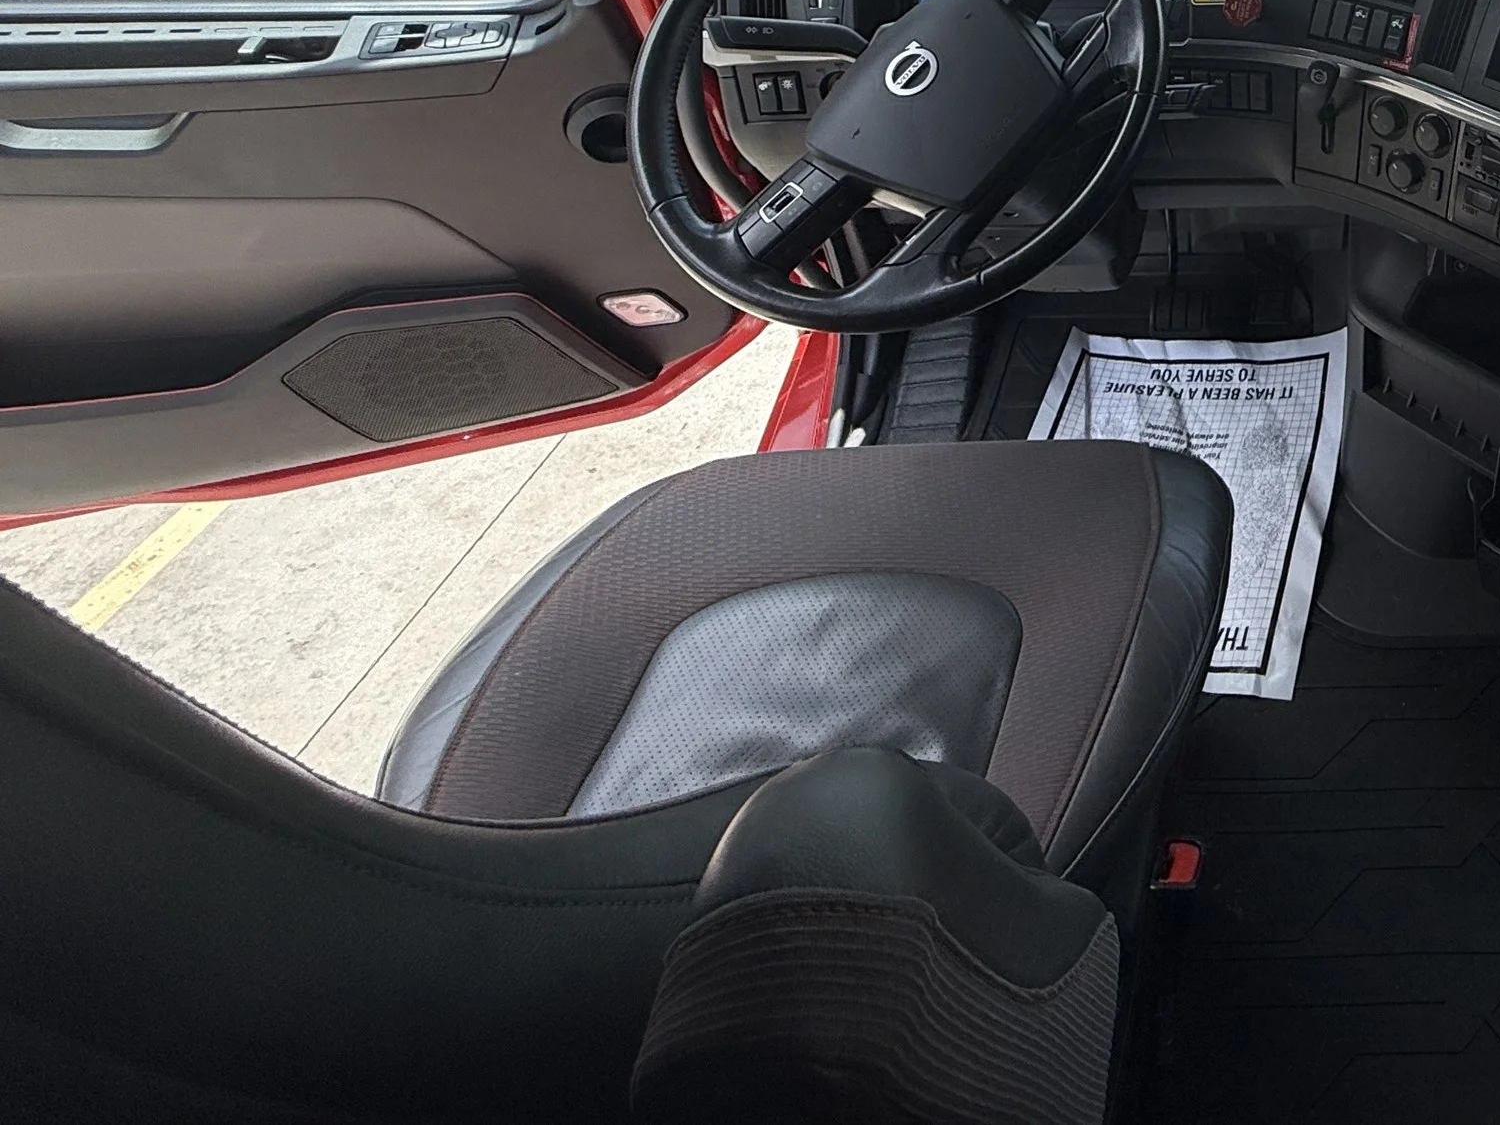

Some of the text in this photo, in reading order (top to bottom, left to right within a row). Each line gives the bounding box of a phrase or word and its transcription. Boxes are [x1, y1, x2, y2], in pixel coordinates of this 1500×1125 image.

[896, 55, 927, 85] VOLVO
[1150, 368, 1257, 383] TO SERVE YOU
[1103, 381, 1294, 401] IT HAS BEEN A PLEASURE
